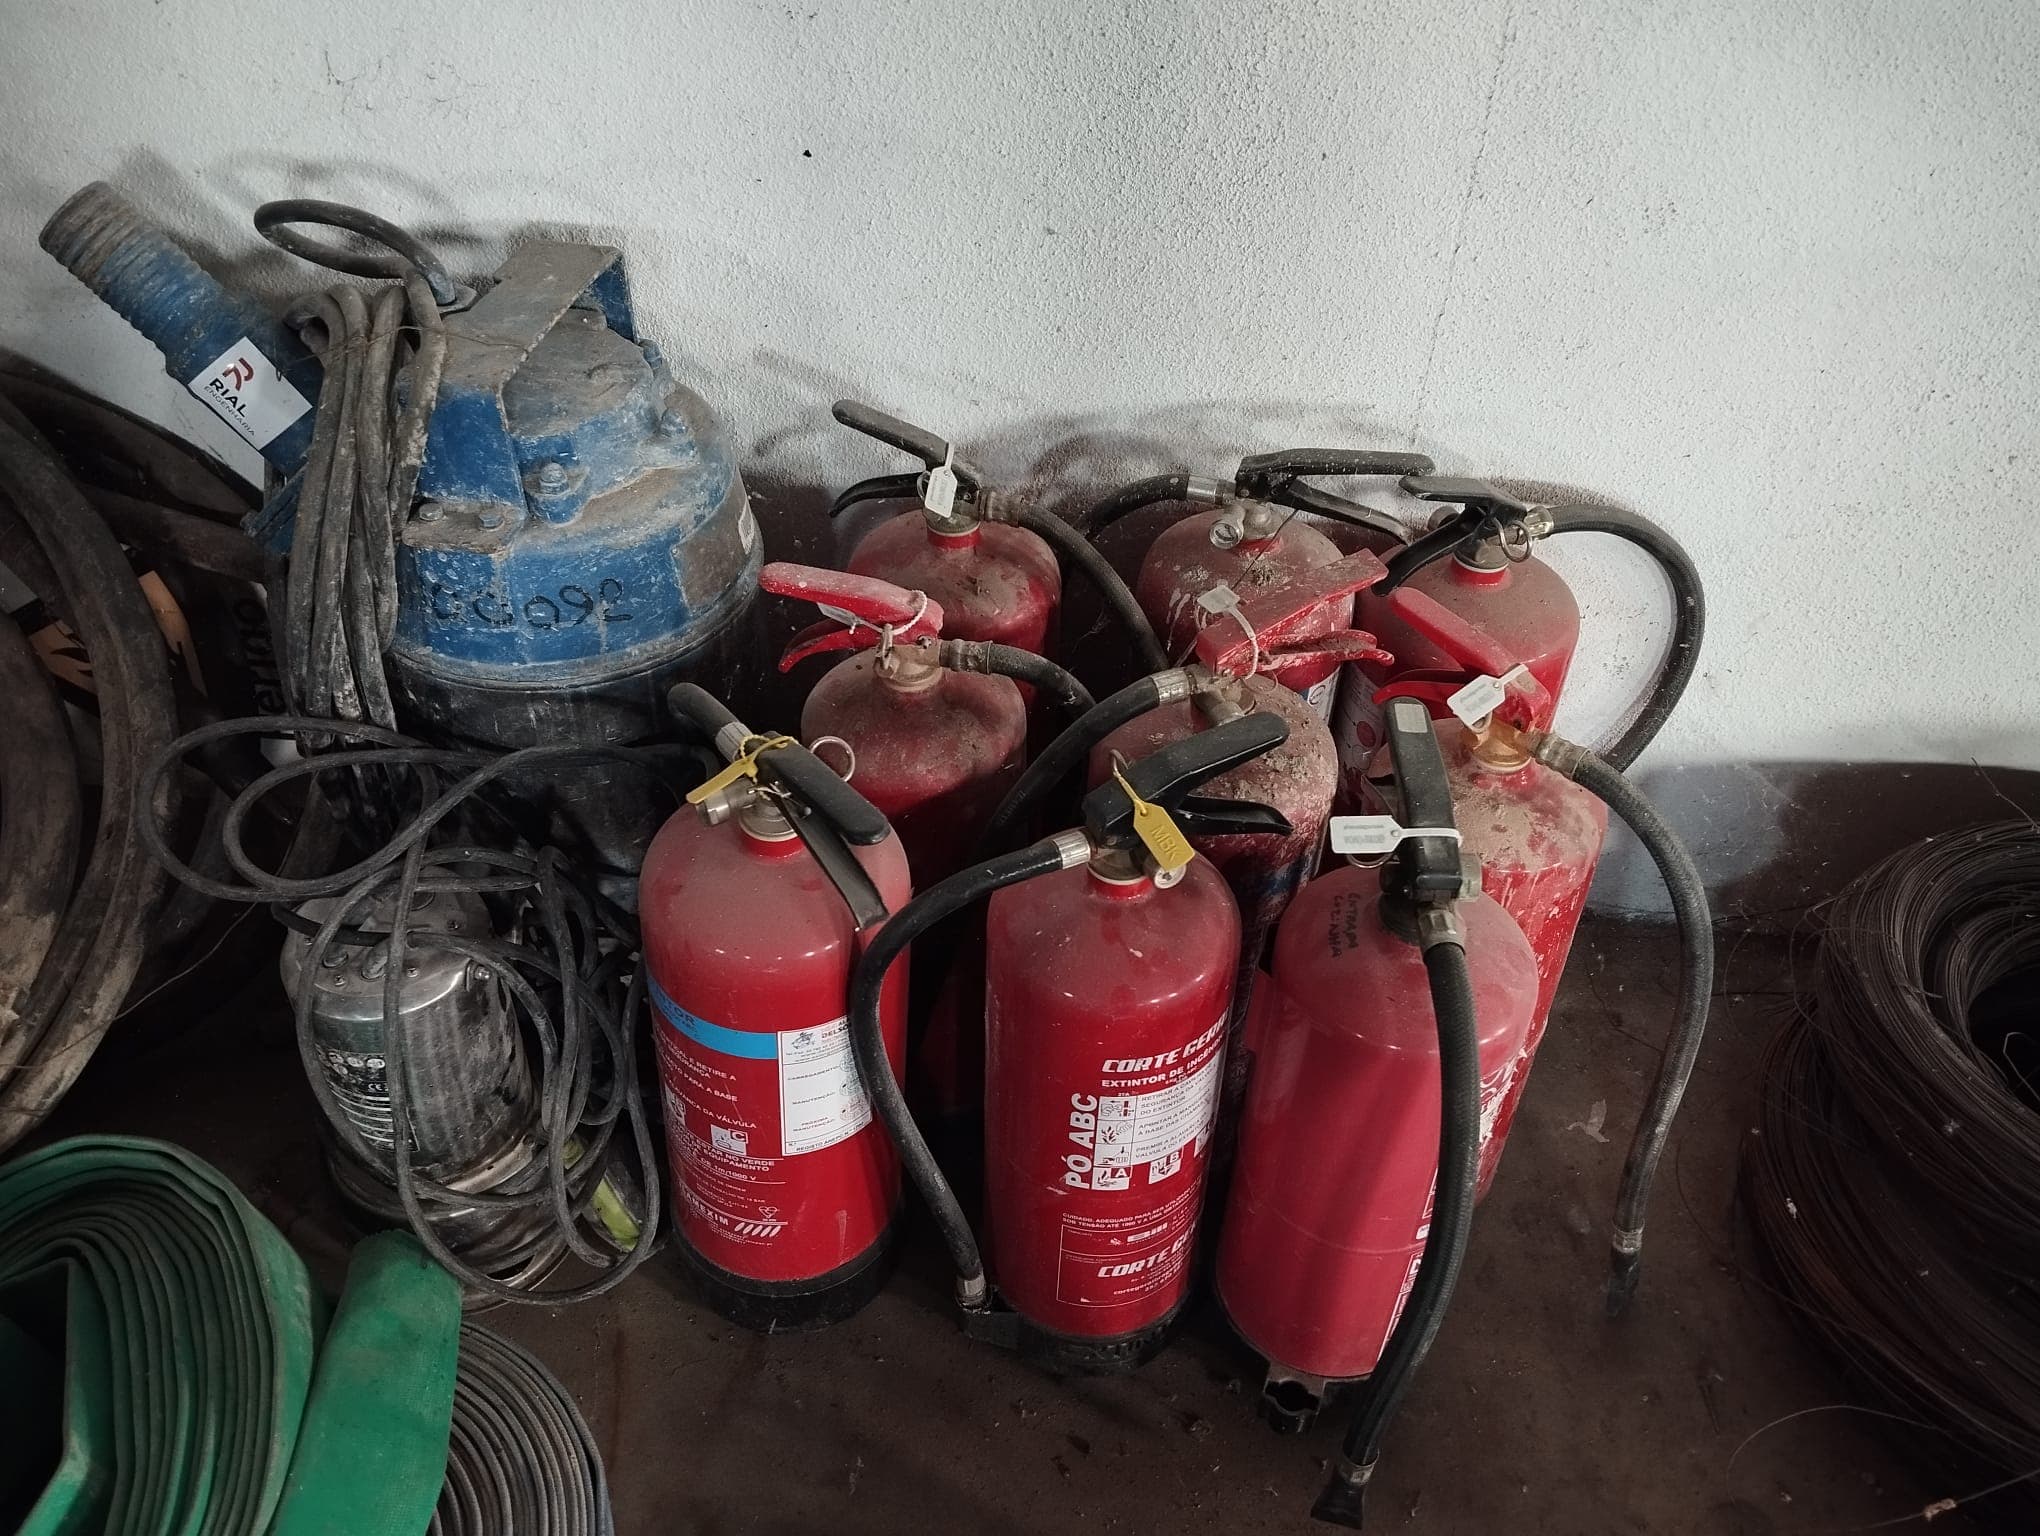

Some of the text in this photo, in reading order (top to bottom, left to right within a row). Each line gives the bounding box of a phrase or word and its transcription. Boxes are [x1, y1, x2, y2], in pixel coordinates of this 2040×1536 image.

[209, 377, 247, 418] RIAL
[203, 385, 256, 437] ENGENHARIA
[696, 1061, 728, 1079] RETIRE
[1101, 1047, 1182, 1073] CORTE
[1101, 1073, 1166, 1088] EXTINTOR
[1169, 1065, 1184, 1078] DE
[713, 1090, 738, 1101] BASE
[716, 1114, 758, 1129] VÁLVULA
[1061, 1093, 1097, 1189] PÓ ABC
[703, 1148, 770, 1172] EQUIPAMENTO
[725, 1153, 740, 1163] NO
[741, 1158, 775, 1168] VERDE
[1114, 1168, 1128, 1178] A
[1078, 1220, 1106, 1229] TENSÃO
[1095, 1216, 1134, 1224] ADEQUADO
[1097, 1246, 1171, 1278] CORTE
